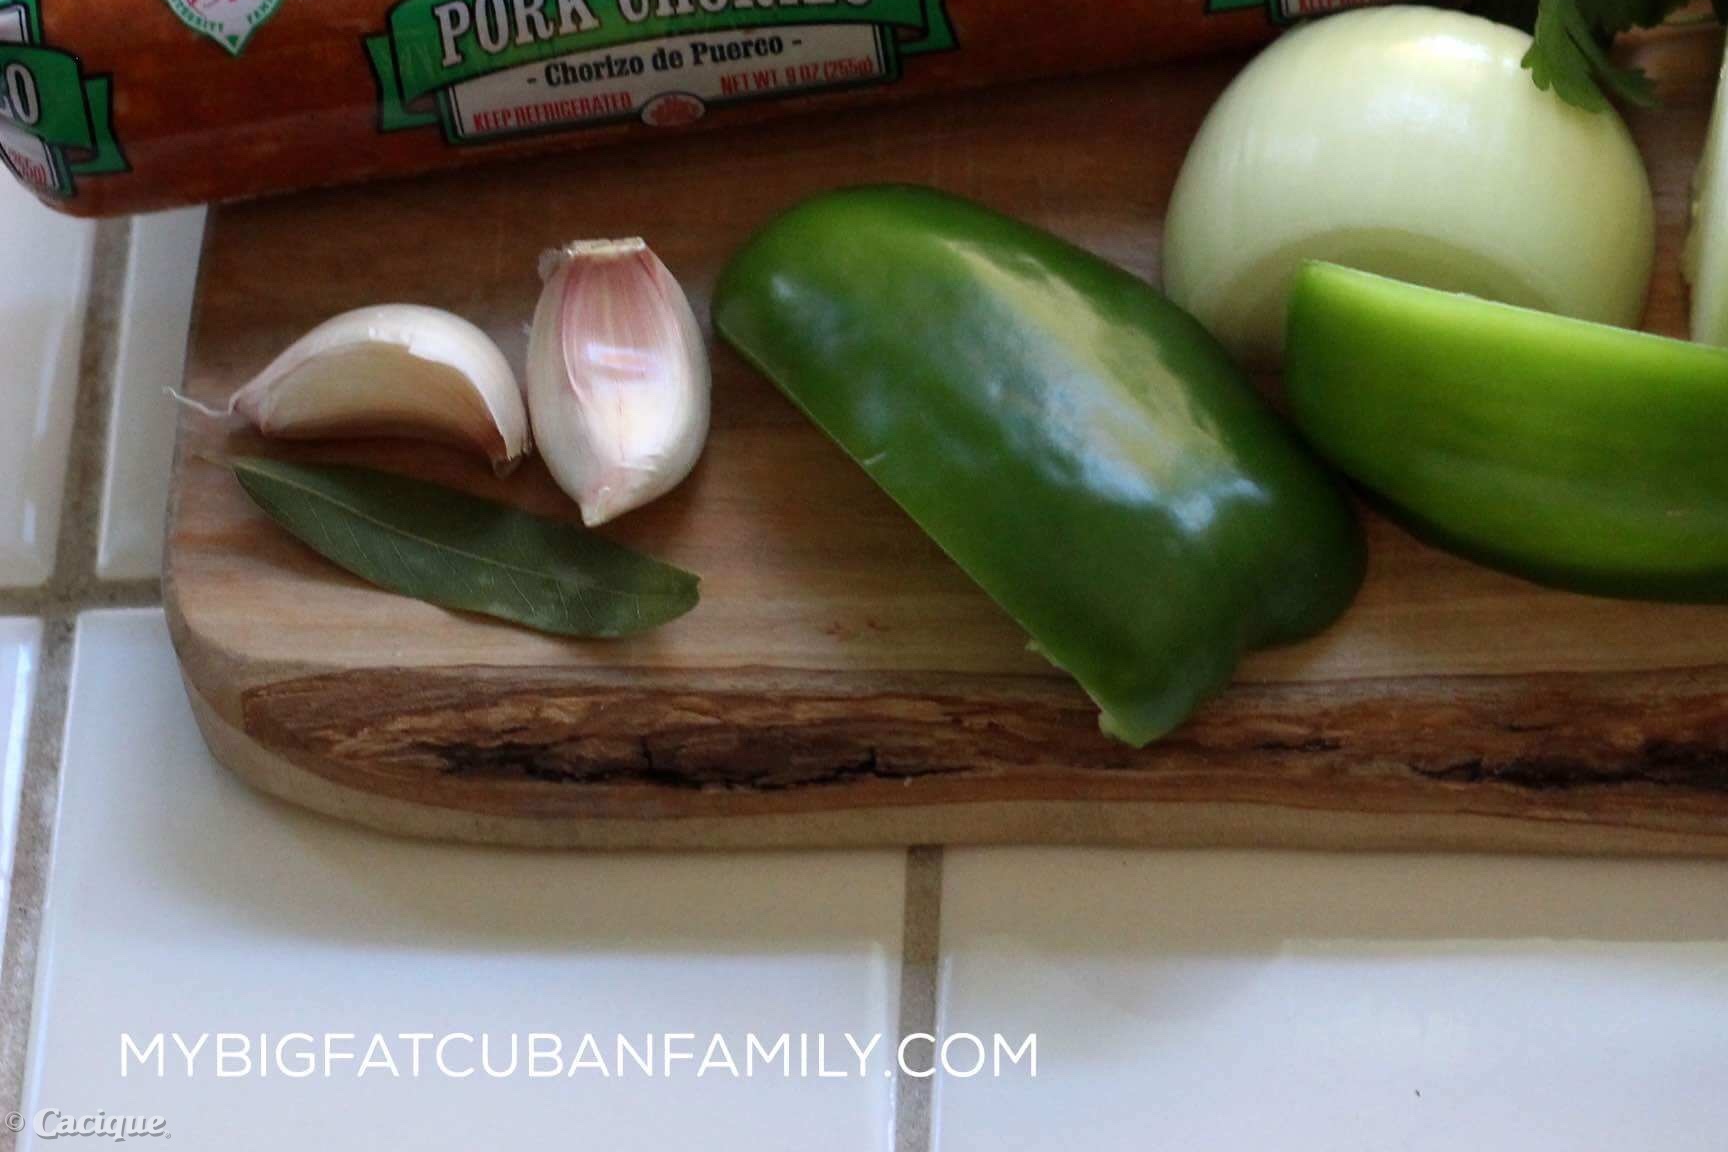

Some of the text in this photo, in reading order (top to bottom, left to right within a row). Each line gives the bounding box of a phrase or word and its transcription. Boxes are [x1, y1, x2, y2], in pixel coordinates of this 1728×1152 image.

[544, 35, 784, 89] Chorizo de Puerco
[472, 106, 516, 132] KEEP
